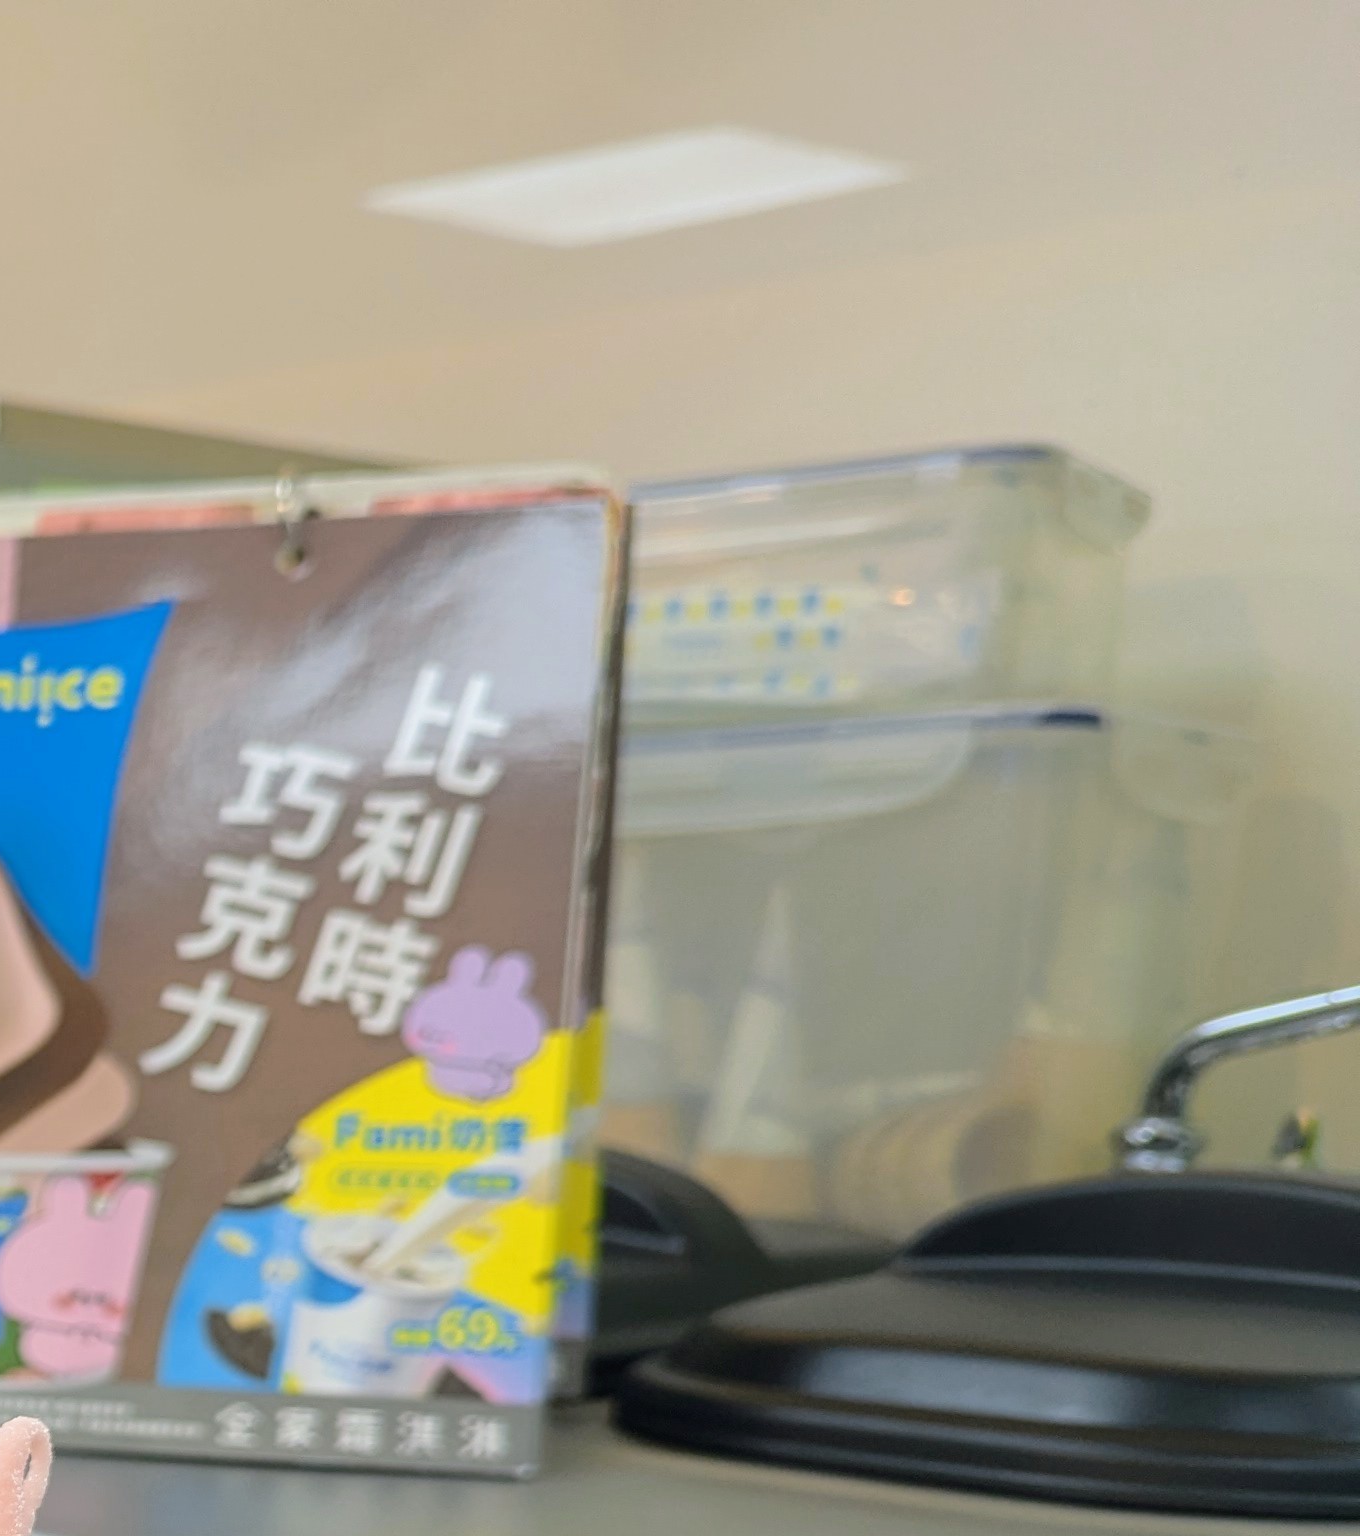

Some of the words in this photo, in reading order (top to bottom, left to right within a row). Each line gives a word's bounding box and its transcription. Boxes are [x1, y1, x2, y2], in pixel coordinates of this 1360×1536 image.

[138, 741, 362, 1094] 巧克力
[297, 662, 510, 1036] 比利時
